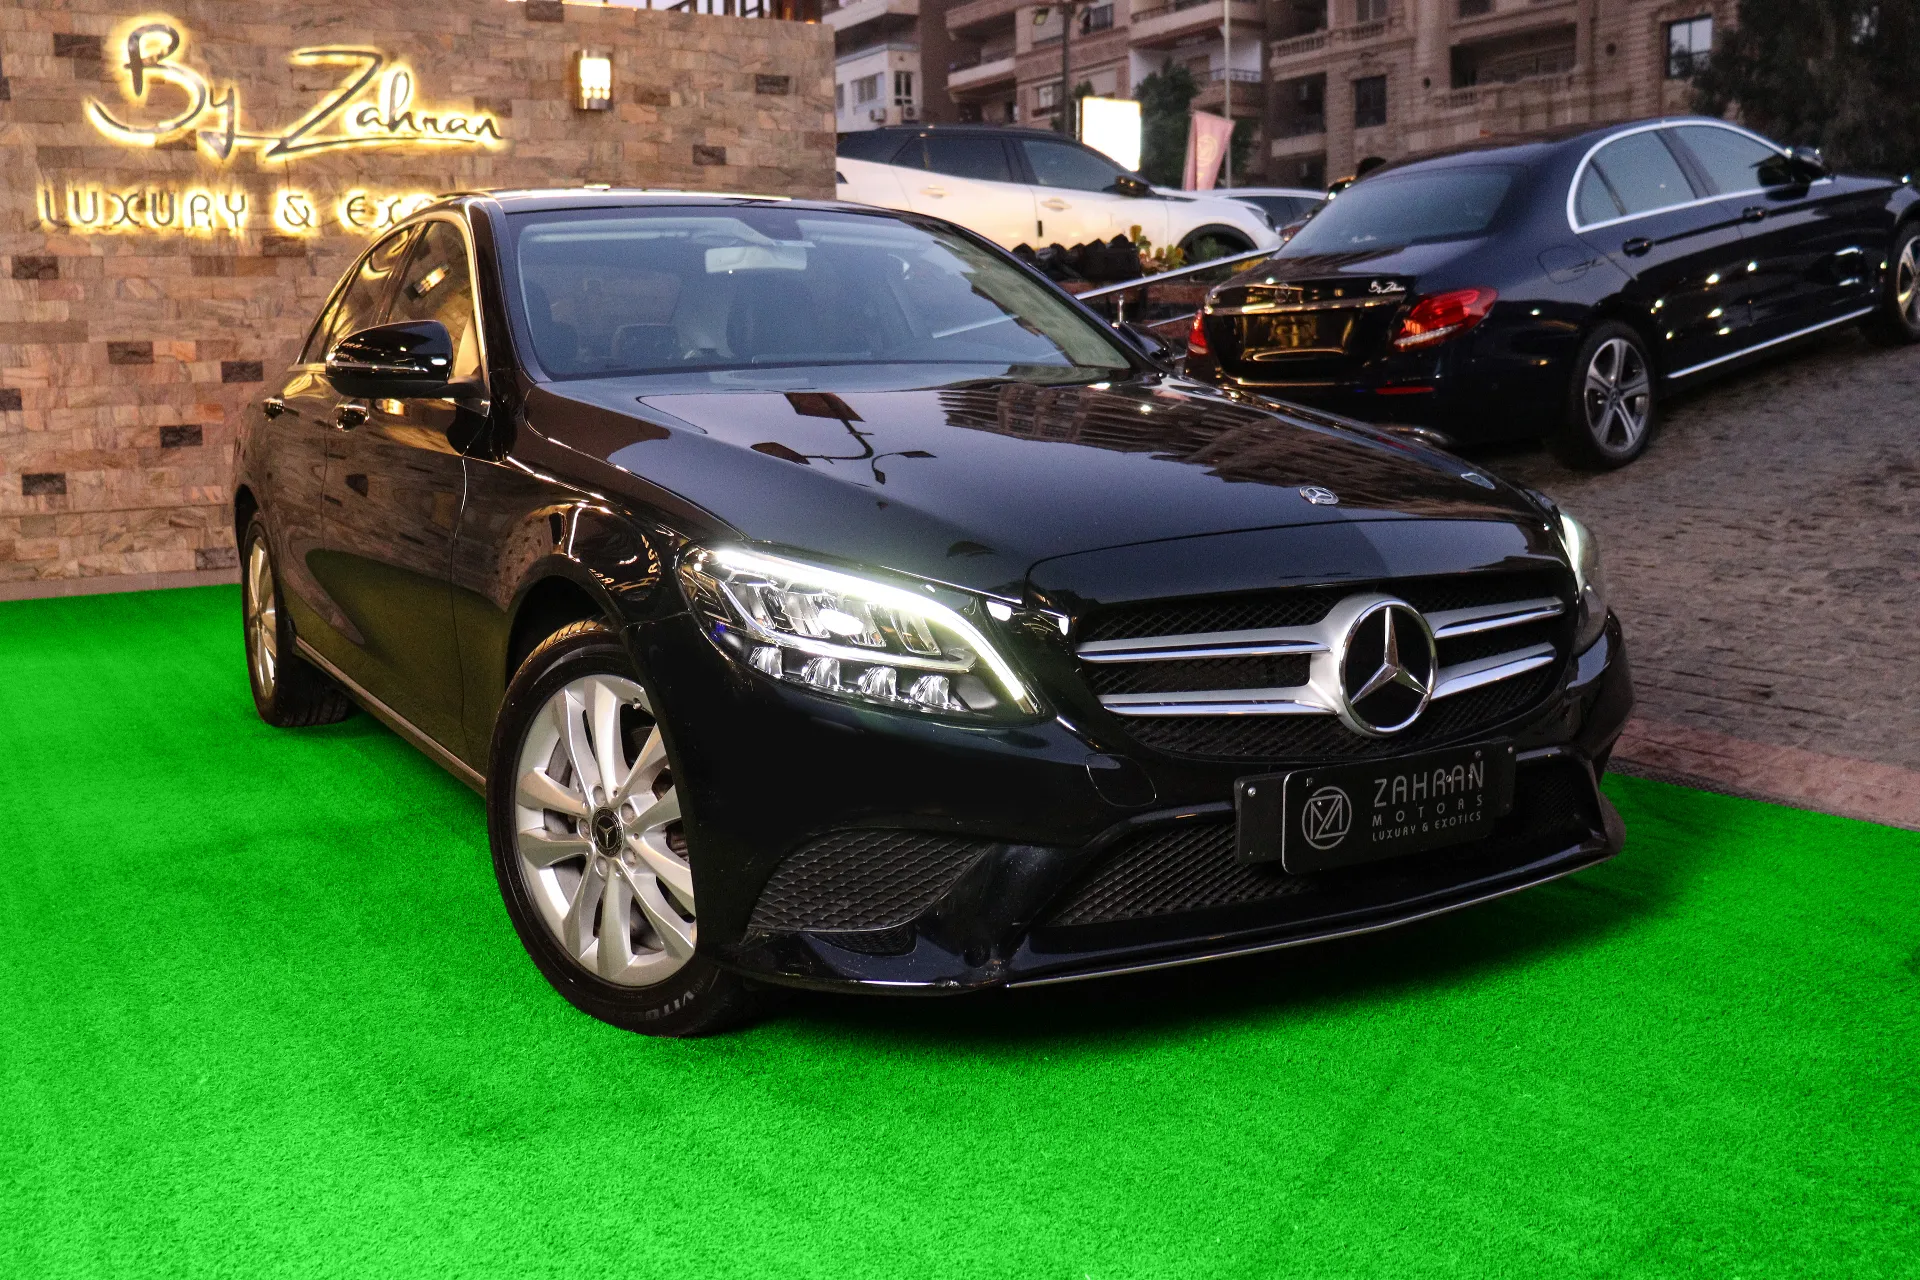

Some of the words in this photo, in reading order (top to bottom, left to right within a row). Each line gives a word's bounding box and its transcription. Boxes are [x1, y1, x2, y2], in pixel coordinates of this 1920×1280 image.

[88, 22, 237, 159] By
[264, 47, 503, 157] Zahran
[44, 189, 246, 228] LUXURY
[283, 195, 312, 228] &
[1373, 761, 1484, 808] ZAHRAN
[1372, 794, 1482, 827] MOTORS
[1372, 825, 1416, 842] LUXURY
[1422, 822, 1429, 832] &
[1434, 812, 1481, 829] EXOTICS
